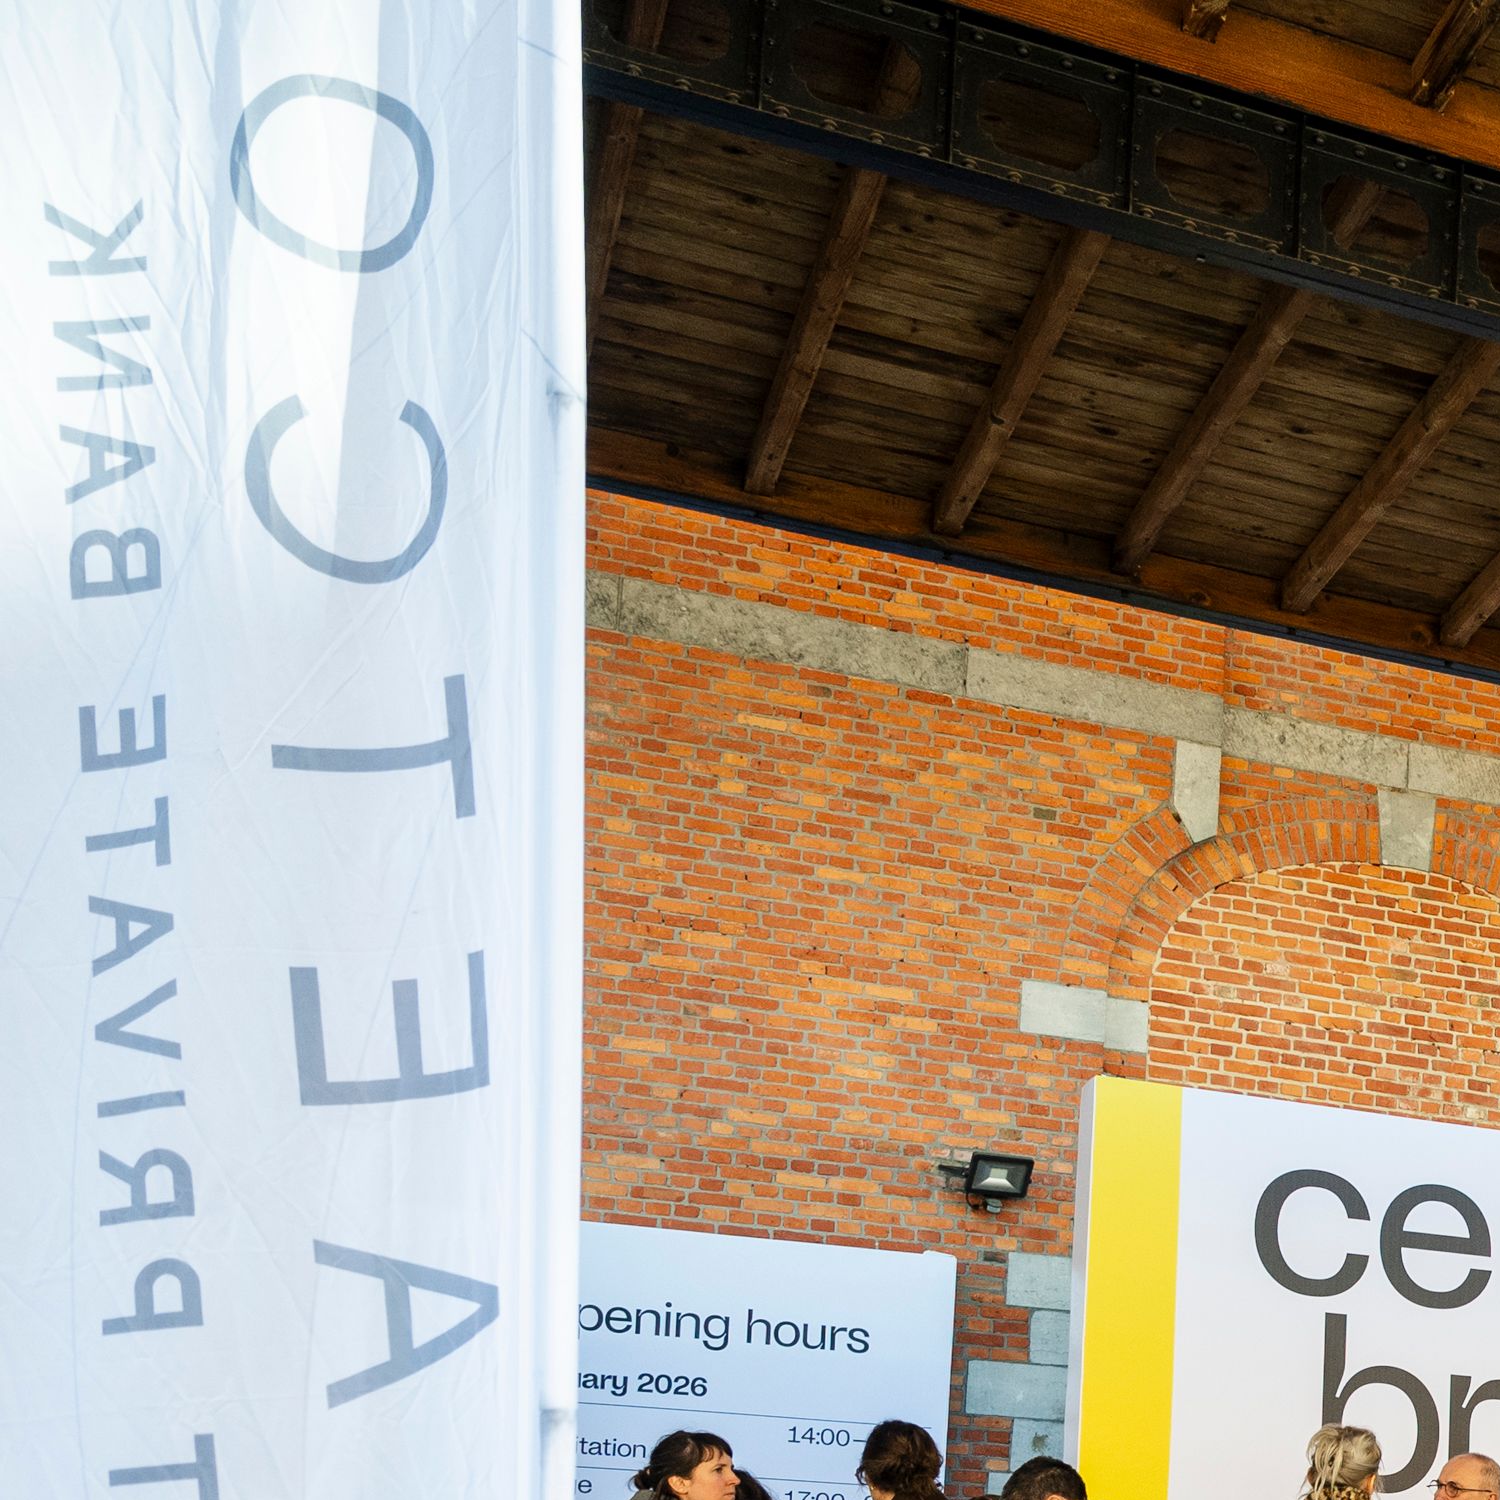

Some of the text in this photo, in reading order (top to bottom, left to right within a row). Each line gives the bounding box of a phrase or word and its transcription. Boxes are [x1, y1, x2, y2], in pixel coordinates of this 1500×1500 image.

[746, 1309, 870, 1354] hours
[578, 1372, 708, 1397] ary 2026
